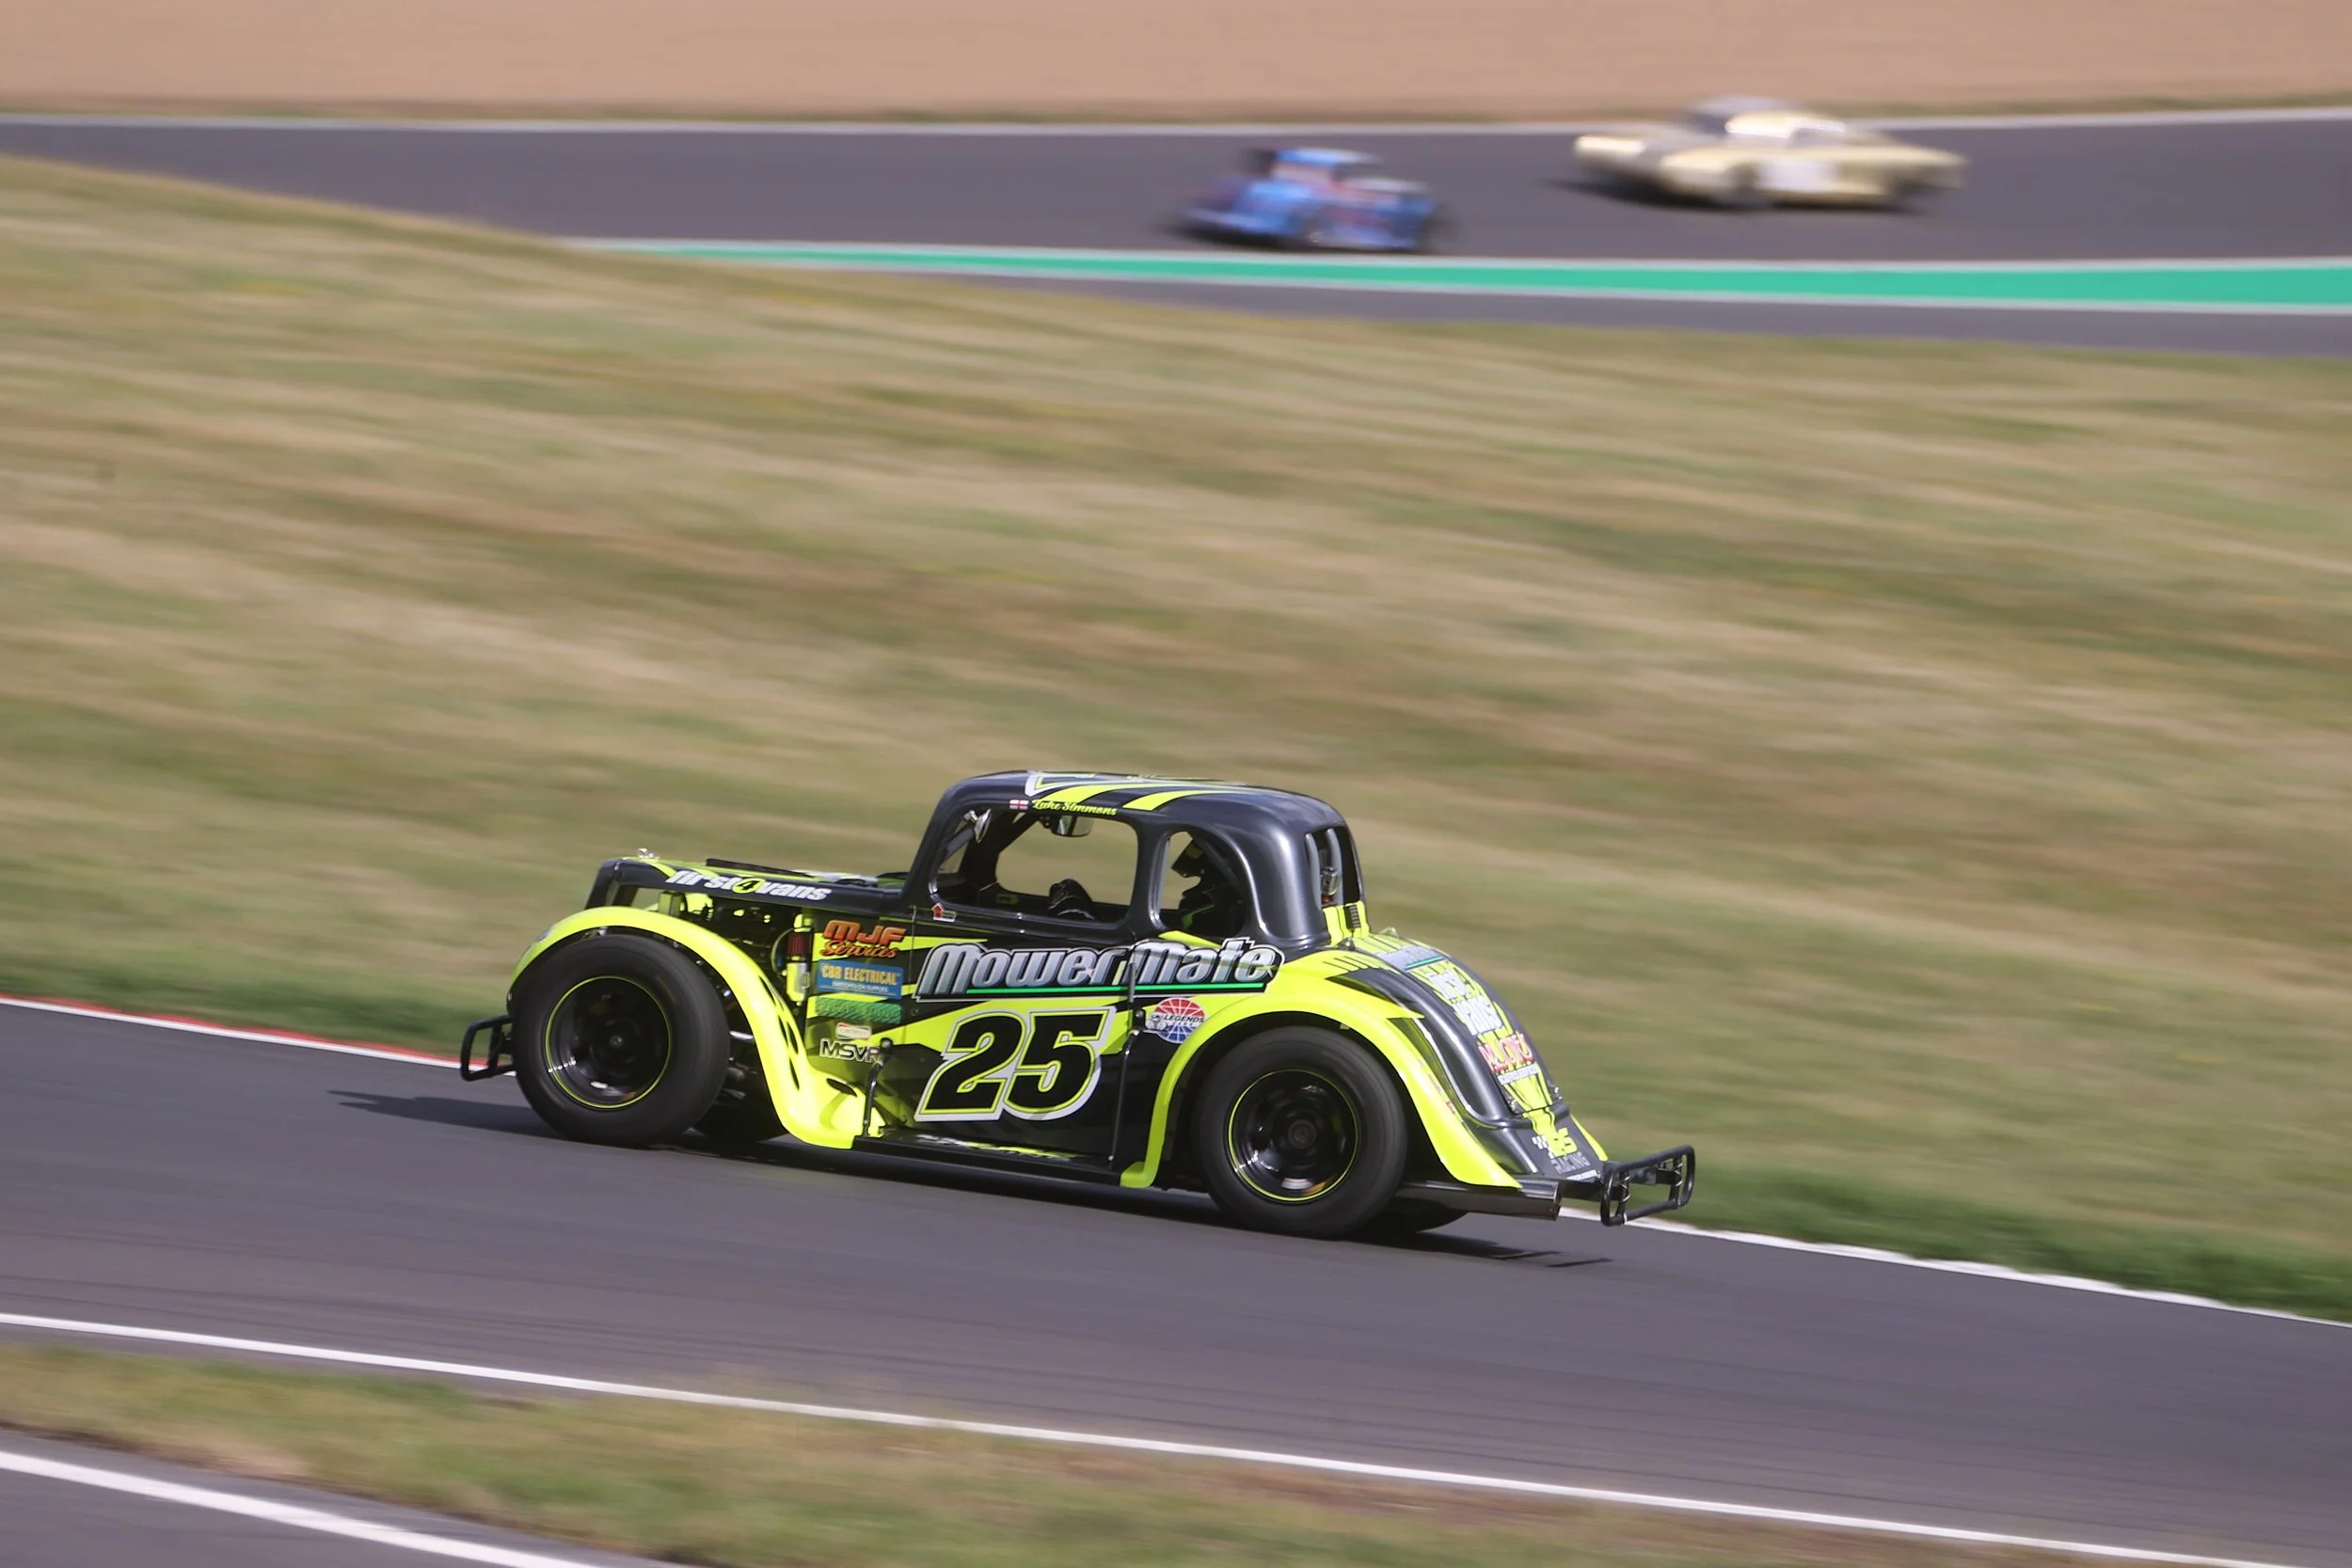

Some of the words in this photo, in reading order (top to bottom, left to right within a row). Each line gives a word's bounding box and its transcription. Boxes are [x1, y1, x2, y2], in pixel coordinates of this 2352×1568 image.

[1062, 802, 1118, 816] Simmons
[823, 920, 907, 945] MJF
[820, 941, 898, 958] Services
[844, 967, 898, 986] ELECTRICAL
[914, 942, 1128, 995] Mower
[1133, 939, 1279, 986] Mate
[914, 1006, 1117, 1121] 25
